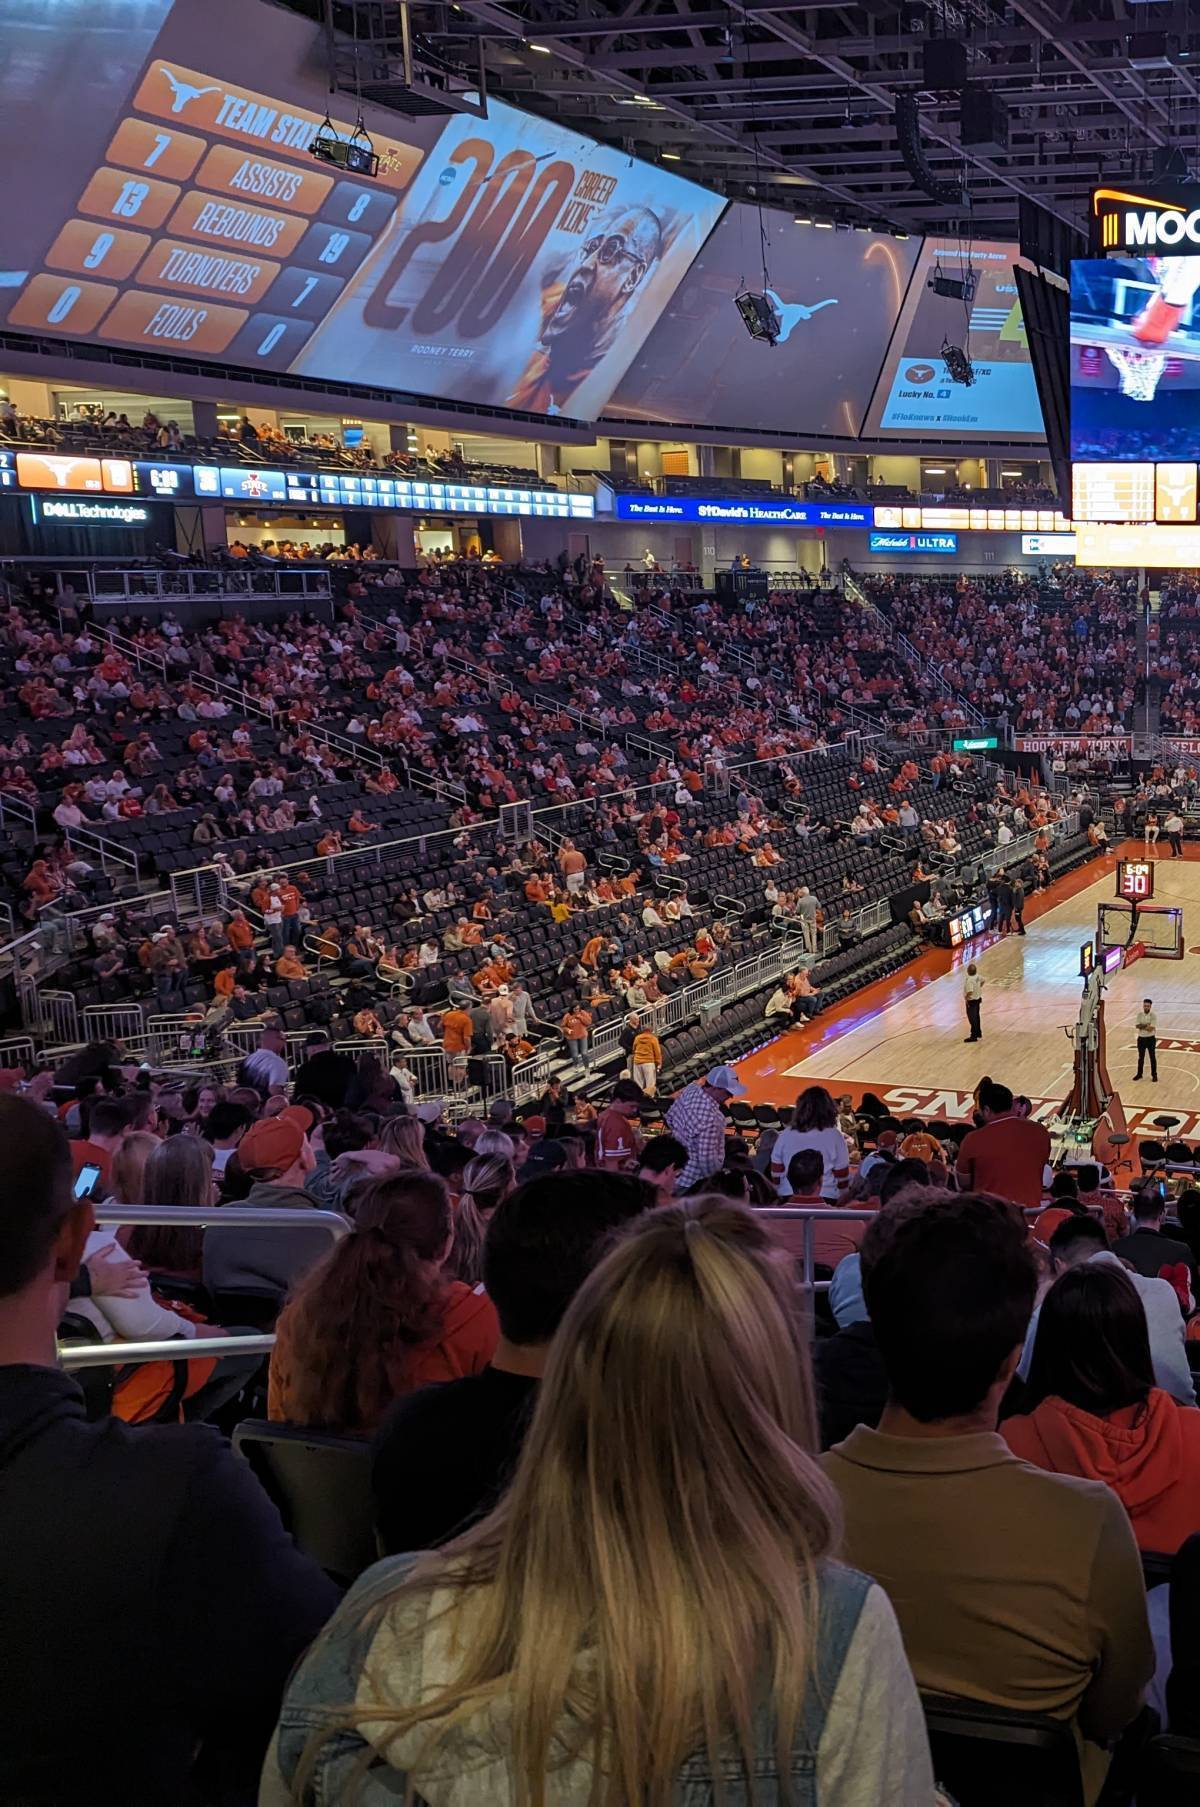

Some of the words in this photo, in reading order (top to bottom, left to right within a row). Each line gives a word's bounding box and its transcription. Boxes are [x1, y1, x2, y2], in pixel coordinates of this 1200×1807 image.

[215, 95, 277, 138] TEAM
[144, 134, 171, 167] 7
[373, 154, 402, 172] TATE
[229, 160, 303, 201] ASSISTS
[112, 181, 150, 217] 13
[347, 193, 370, 222] 8
[192, 202, 285, 247] REBOUNDS
[363, 137, 575, 339] 200
[83, 233, 114, 269] 9
[318, 233, 350, 264] 19
[159, 248, 260, 294] TURNOVERS
[47, 286, 81, 324] 0
[292, 277, 319, 307] 7
[144, 304, 208, 341] FOULS
[257, 324, 287, 356] 0
[411, 344, 447, 355] RODNEY
[448, 346, 476, 358] TERRY
[899, 390, 921, 399] Lucky
[923, 391, 935, 399] No.
[42, 502, 78, 518] DELL
[77, 504, 147, 522] Technologies
[704, 546, 715, 556] 110
[917, 538, 956, 548] ULTRA
[984, 552, 995, 560] 111
[1023, 740, 1056, 752] HOOK
[1124, 875, 1146, 893] 30
[1126, 864, 1149, 875] 6:09
[616, 1137, 624, 1150] 1
